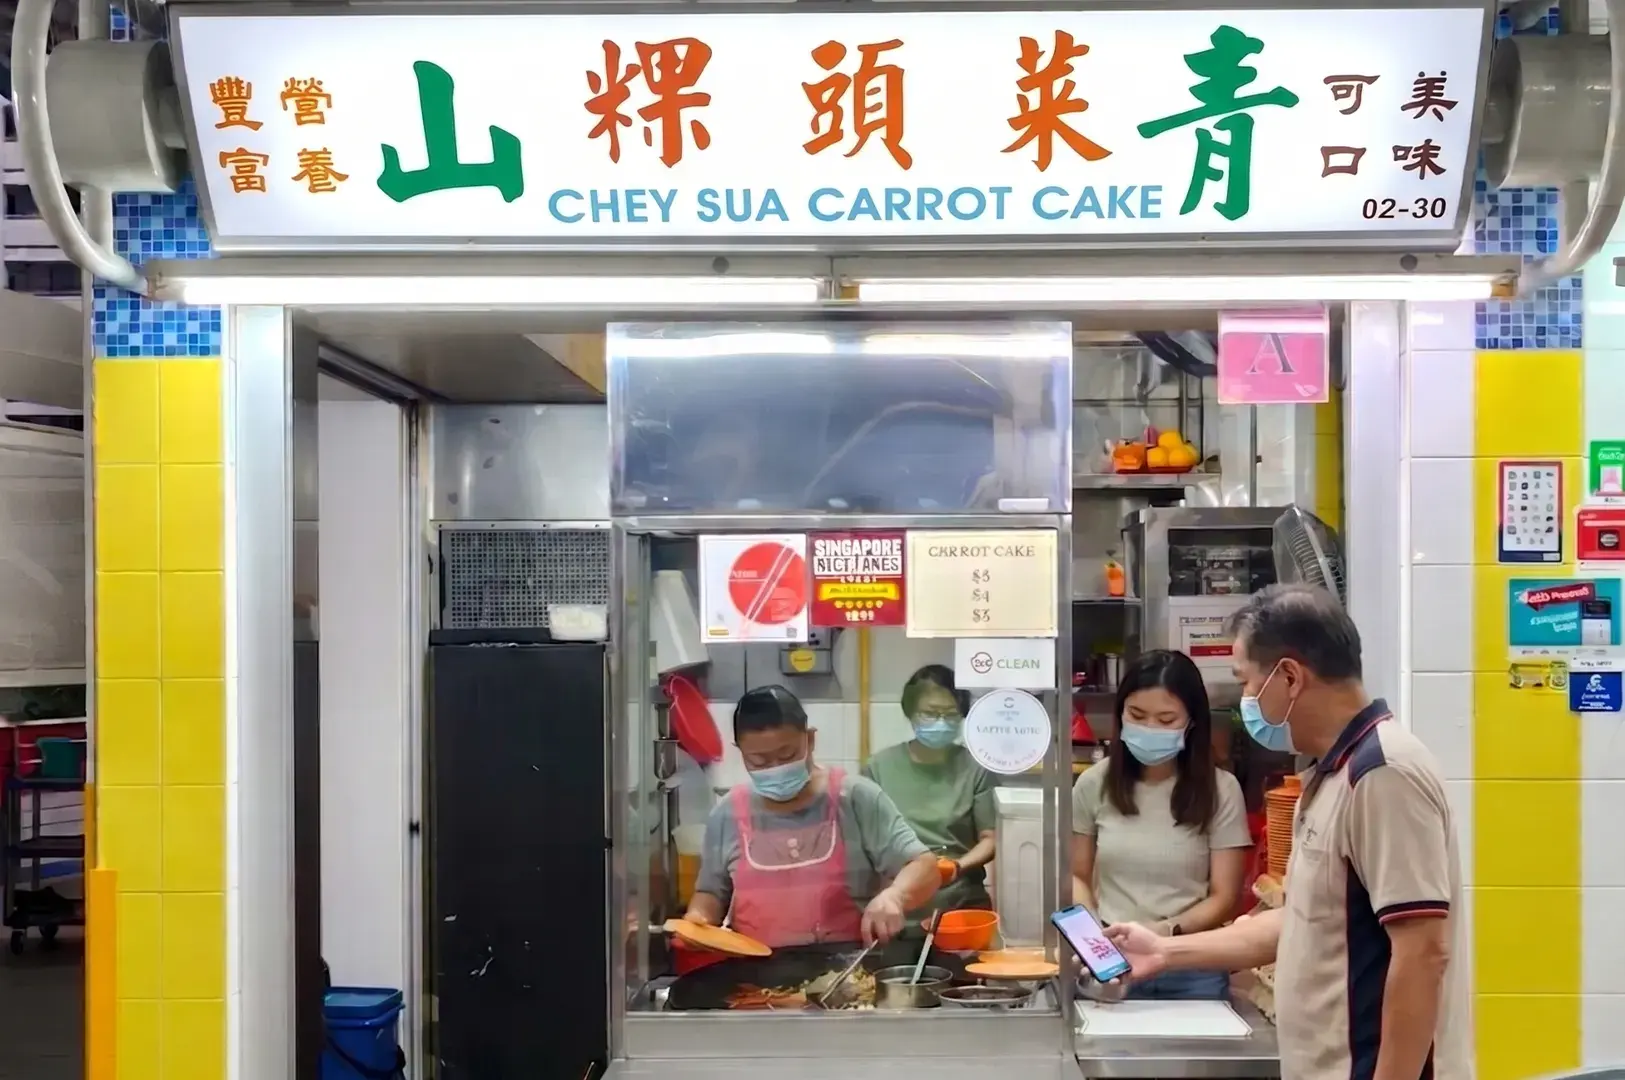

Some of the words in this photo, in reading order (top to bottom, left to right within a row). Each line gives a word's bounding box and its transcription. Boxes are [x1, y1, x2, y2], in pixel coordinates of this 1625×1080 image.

[377, 61, 523, 203] 山
[1137, 25, 1299, 220] 青
[549, 190, 676, 222] CHEY
[698, 189, 787, 221] SUA
[809, 187, 1009, 221] CARROT
[1033, 186, 1160, 219] CAKE
[1363, 198, 1446, 219] 02-30
[1245, 333, 1297, 375] A
[814, 539, 902, 556] SINGAPORE
[928, 546, 991, 557] CARROT
[994, 546, 1036, 557] CAKE
[996, 659, 1040, 669] CLEAN
